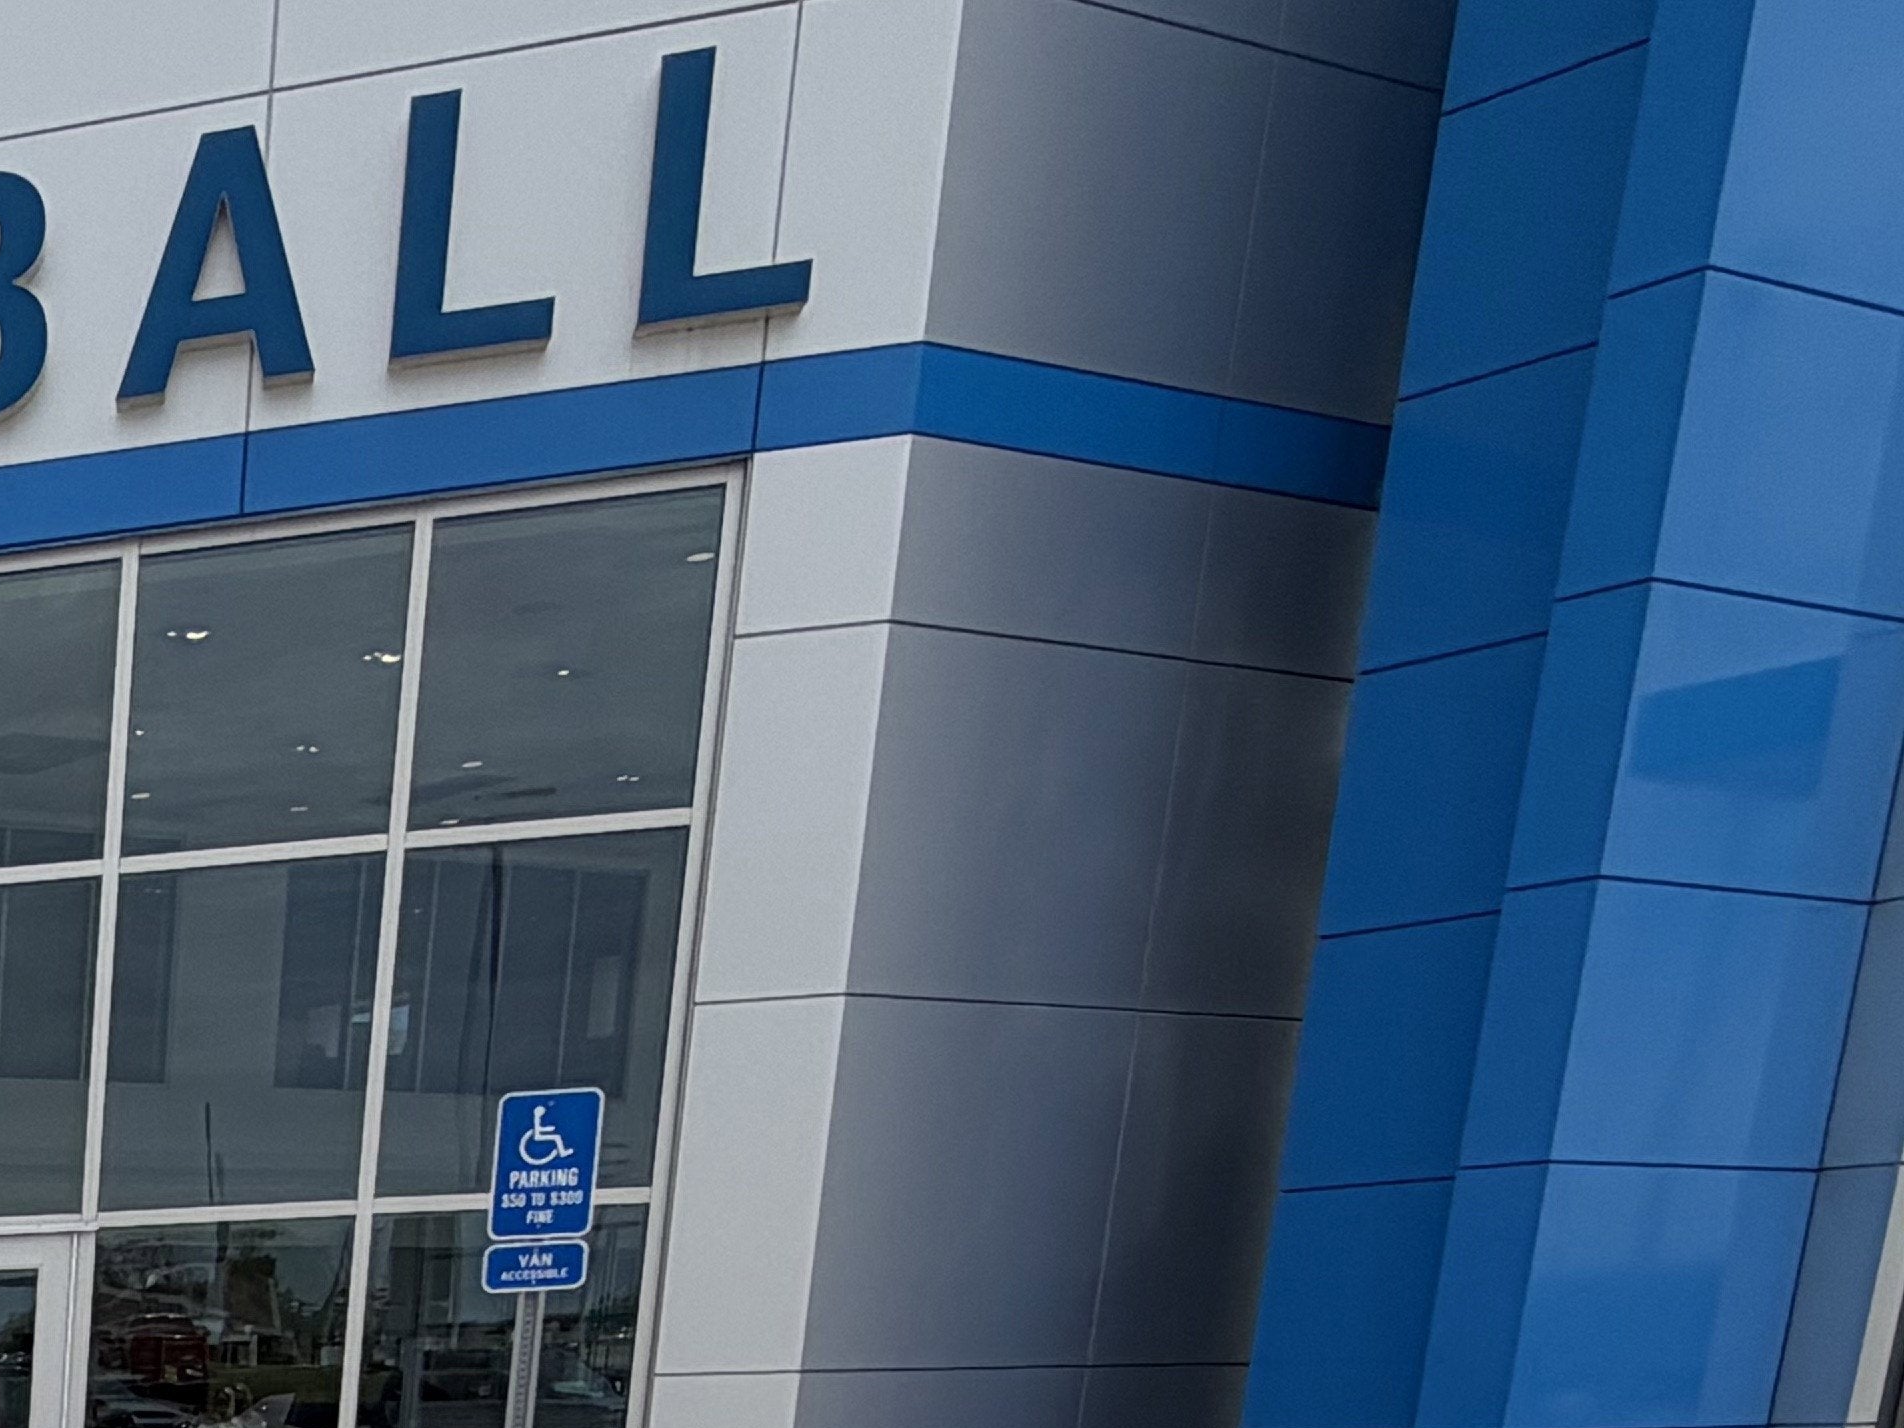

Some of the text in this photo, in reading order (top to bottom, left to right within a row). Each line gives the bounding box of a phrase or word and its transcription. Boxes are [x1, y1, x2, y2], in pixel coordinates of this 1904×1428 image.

[509, 1167, 579, 1189] PARKING
[530, 1192, 546, 1207] TO
[526, 1209, 554, 1223] FINE
[518, 1252, 553, 1266] VAN
[500, 1268, 569, 1281] ACCESSIBLE
